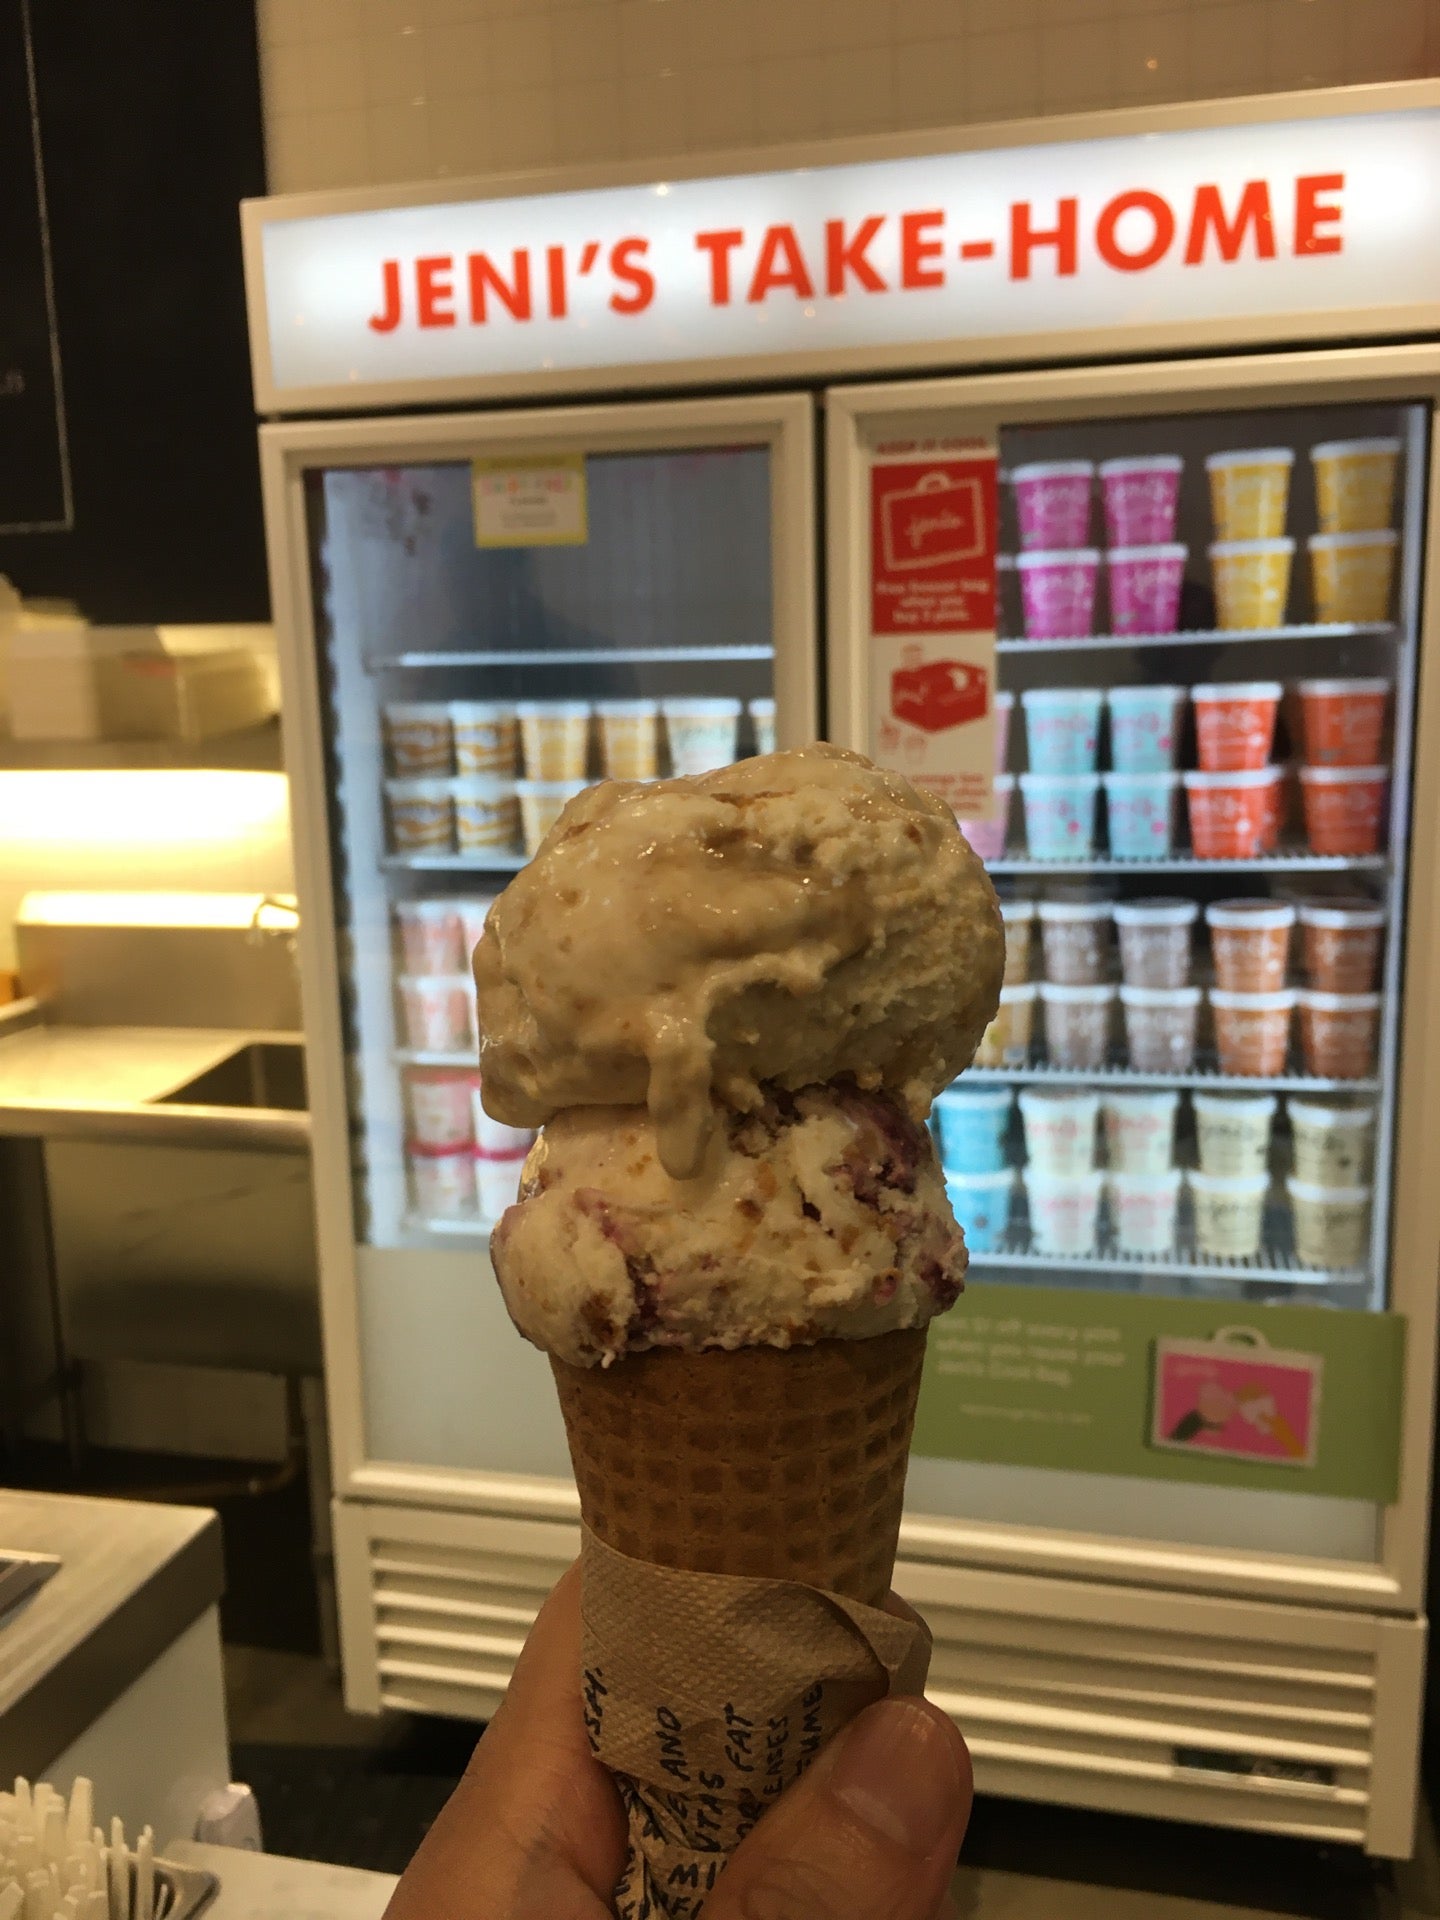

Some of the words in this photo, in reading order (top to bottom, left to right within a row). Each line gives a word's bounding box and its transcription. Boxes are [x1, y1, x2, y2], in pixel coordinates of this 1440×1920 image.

[369, 236, 656, 333] JENI'S
[697, 172, 1346, 307] TAKE-HOME
[656, 1706, 691, 1781] AND
[723, 1702, 754, 1772] FAT
